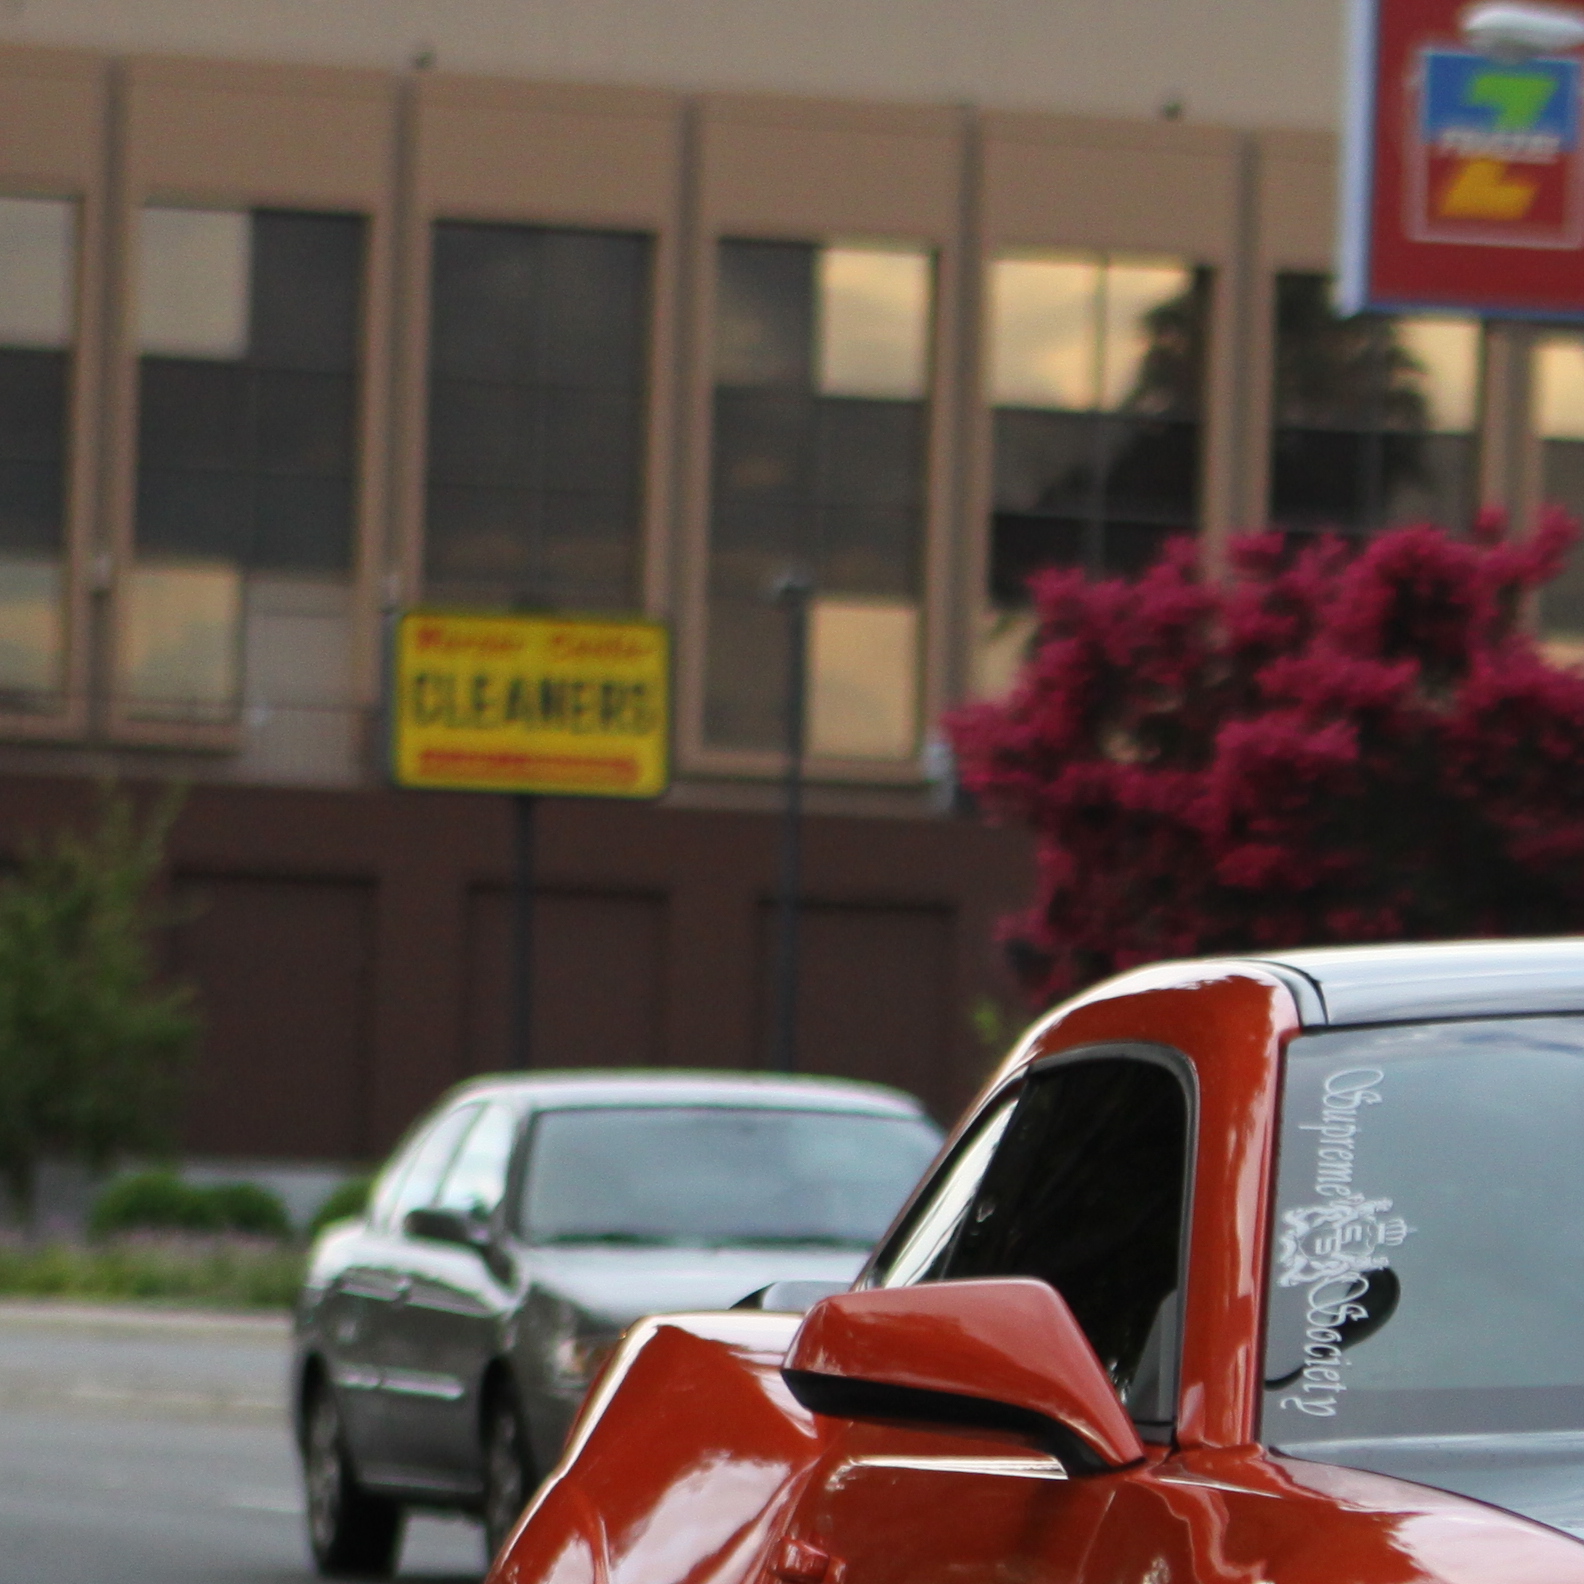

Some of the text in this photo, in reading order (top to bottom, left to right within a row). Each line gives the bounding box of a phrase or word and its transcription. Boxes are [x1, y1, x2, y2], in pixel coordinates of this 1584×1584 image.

[412, 672, 657, 737] CLEANERS
[1298, 1068, 1385, 1198] Supreme
[1280, 1275, 1371, 1417] Society
